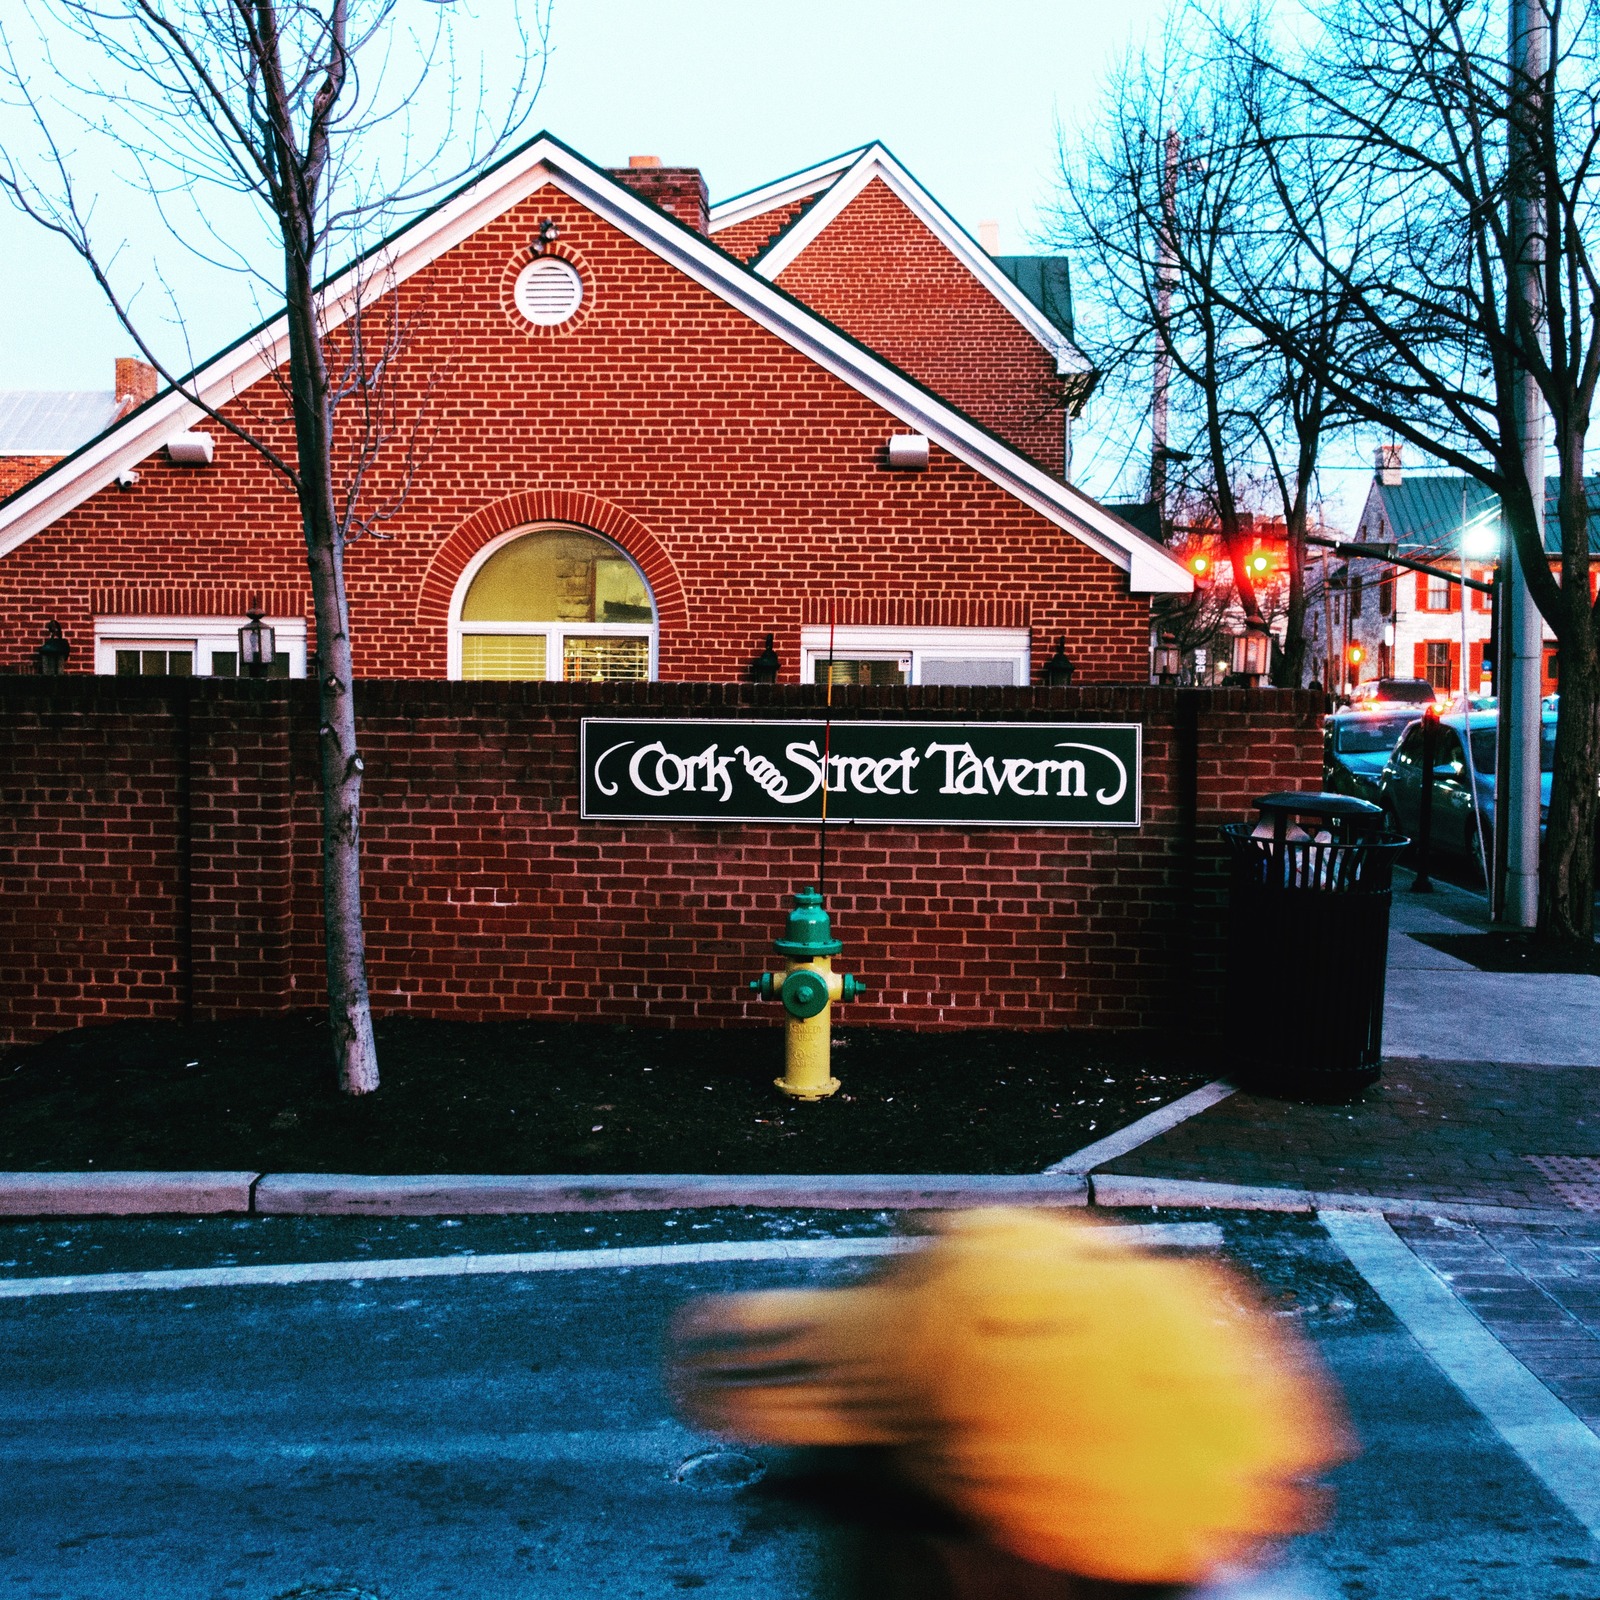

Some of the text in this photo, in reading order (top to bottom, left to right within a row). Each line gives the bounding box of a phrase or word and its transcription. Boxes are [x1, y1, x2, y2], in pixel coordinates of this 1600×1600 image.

[628, 740, 1088, 804] Cork Street Tavern
